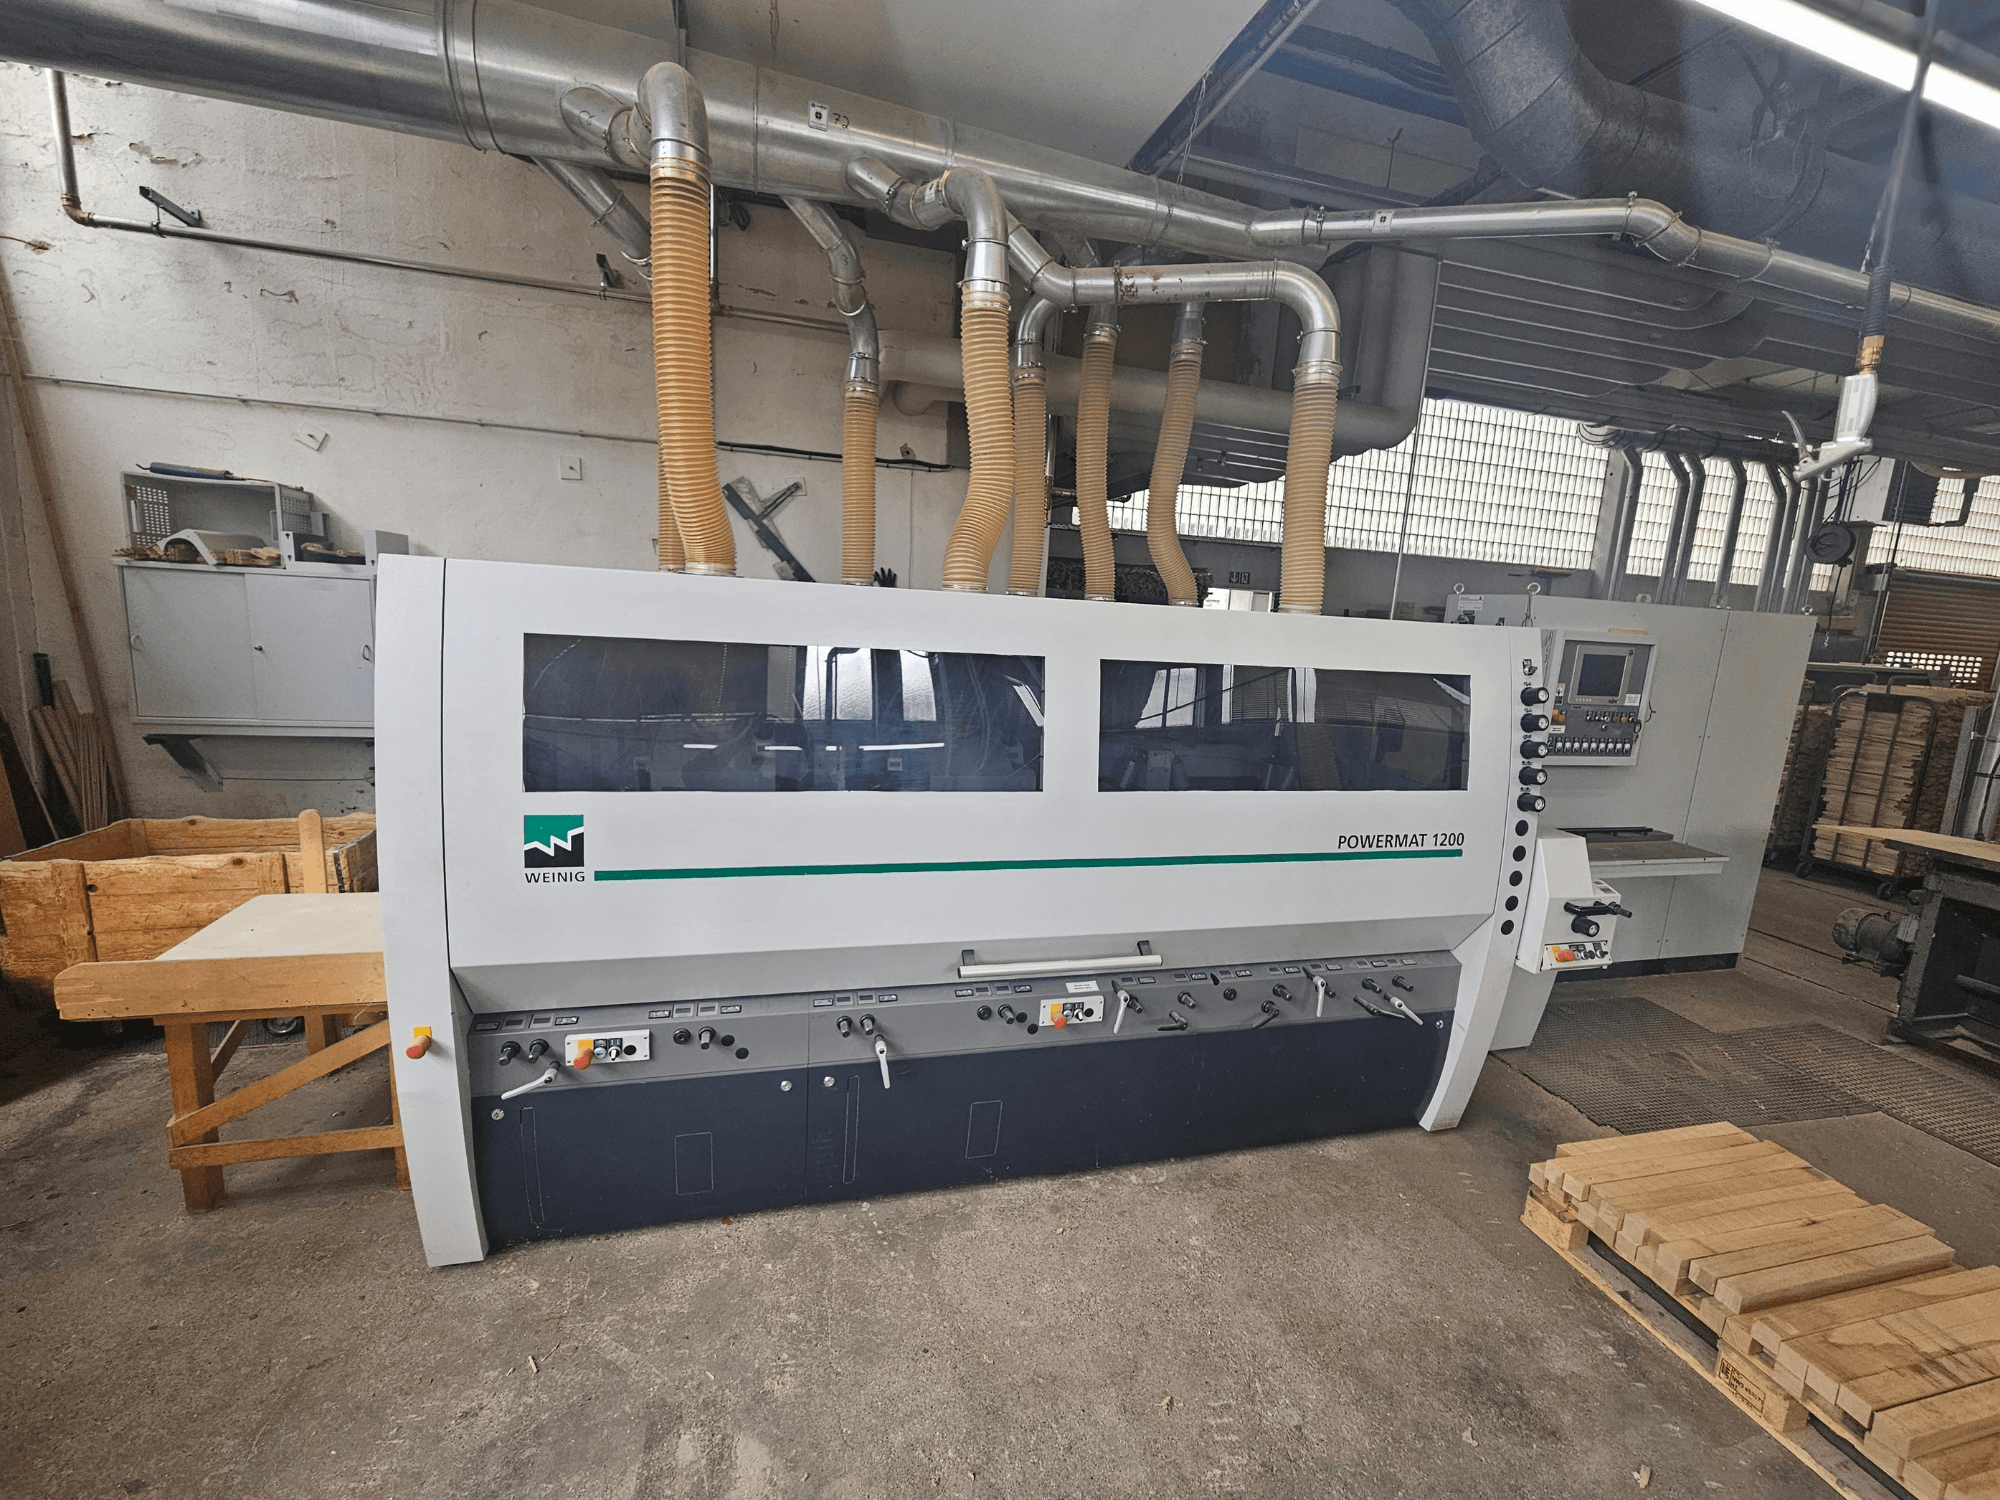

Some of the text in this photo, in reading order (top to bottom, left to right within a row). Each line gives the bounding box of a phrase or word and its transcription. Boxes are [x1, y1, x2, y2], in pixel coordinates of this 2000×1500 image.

[832, 112, 850, 129] 72
[1338, 832, 1465, 849] POWERMAT 1200
[524, 871, 585, 883] WEINIG
